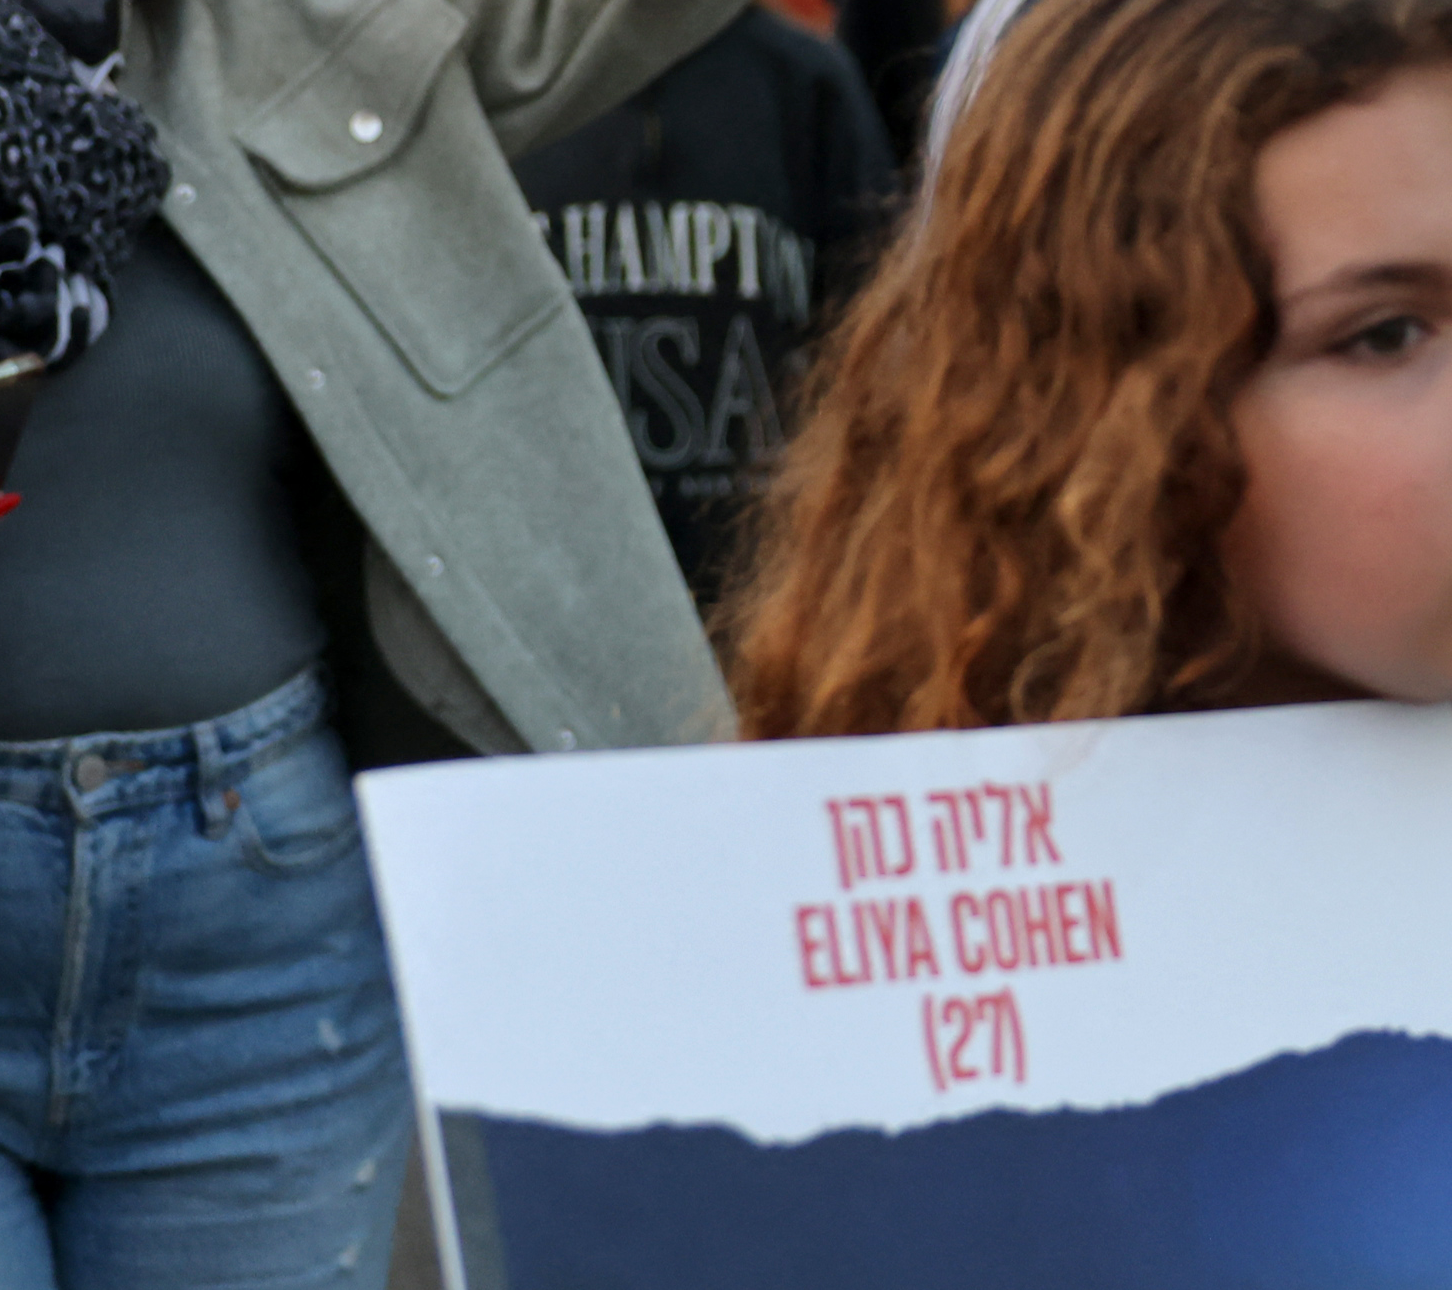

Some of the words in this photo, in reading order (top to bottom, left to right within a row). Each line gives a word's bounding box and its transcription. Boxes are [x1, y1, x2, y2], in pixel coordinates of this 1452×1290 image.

[825, 793, 917, 891] כהן
[927, 780, 1063, 872] אליה
[796, 894, 941, 990] ELIYA
[951, 878, 1125, 975] COHEN
[922, 985, 1027, 1093] (27)
